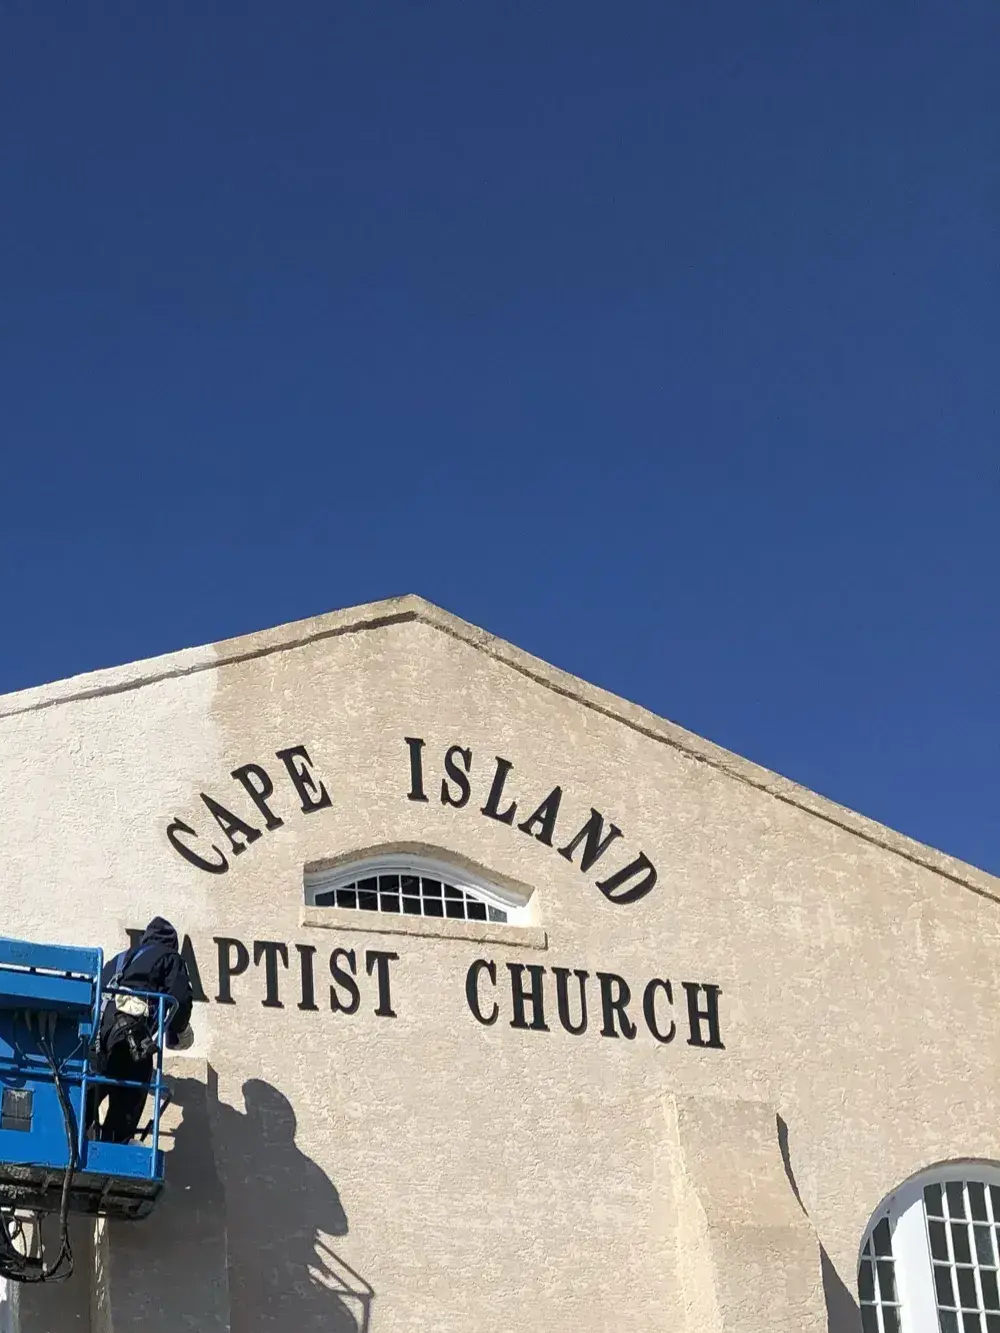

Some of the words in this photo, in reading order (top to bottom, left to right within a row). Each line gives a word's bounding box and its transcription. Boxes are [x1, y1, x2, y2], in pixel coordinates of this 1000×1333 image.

[167, 745, 333, 874] CAPE
[404, 737, 659, 904] ISLAND
[125, 928, 399, 1018] APTIST
[466, 959, 725, 1050] CHURCH
